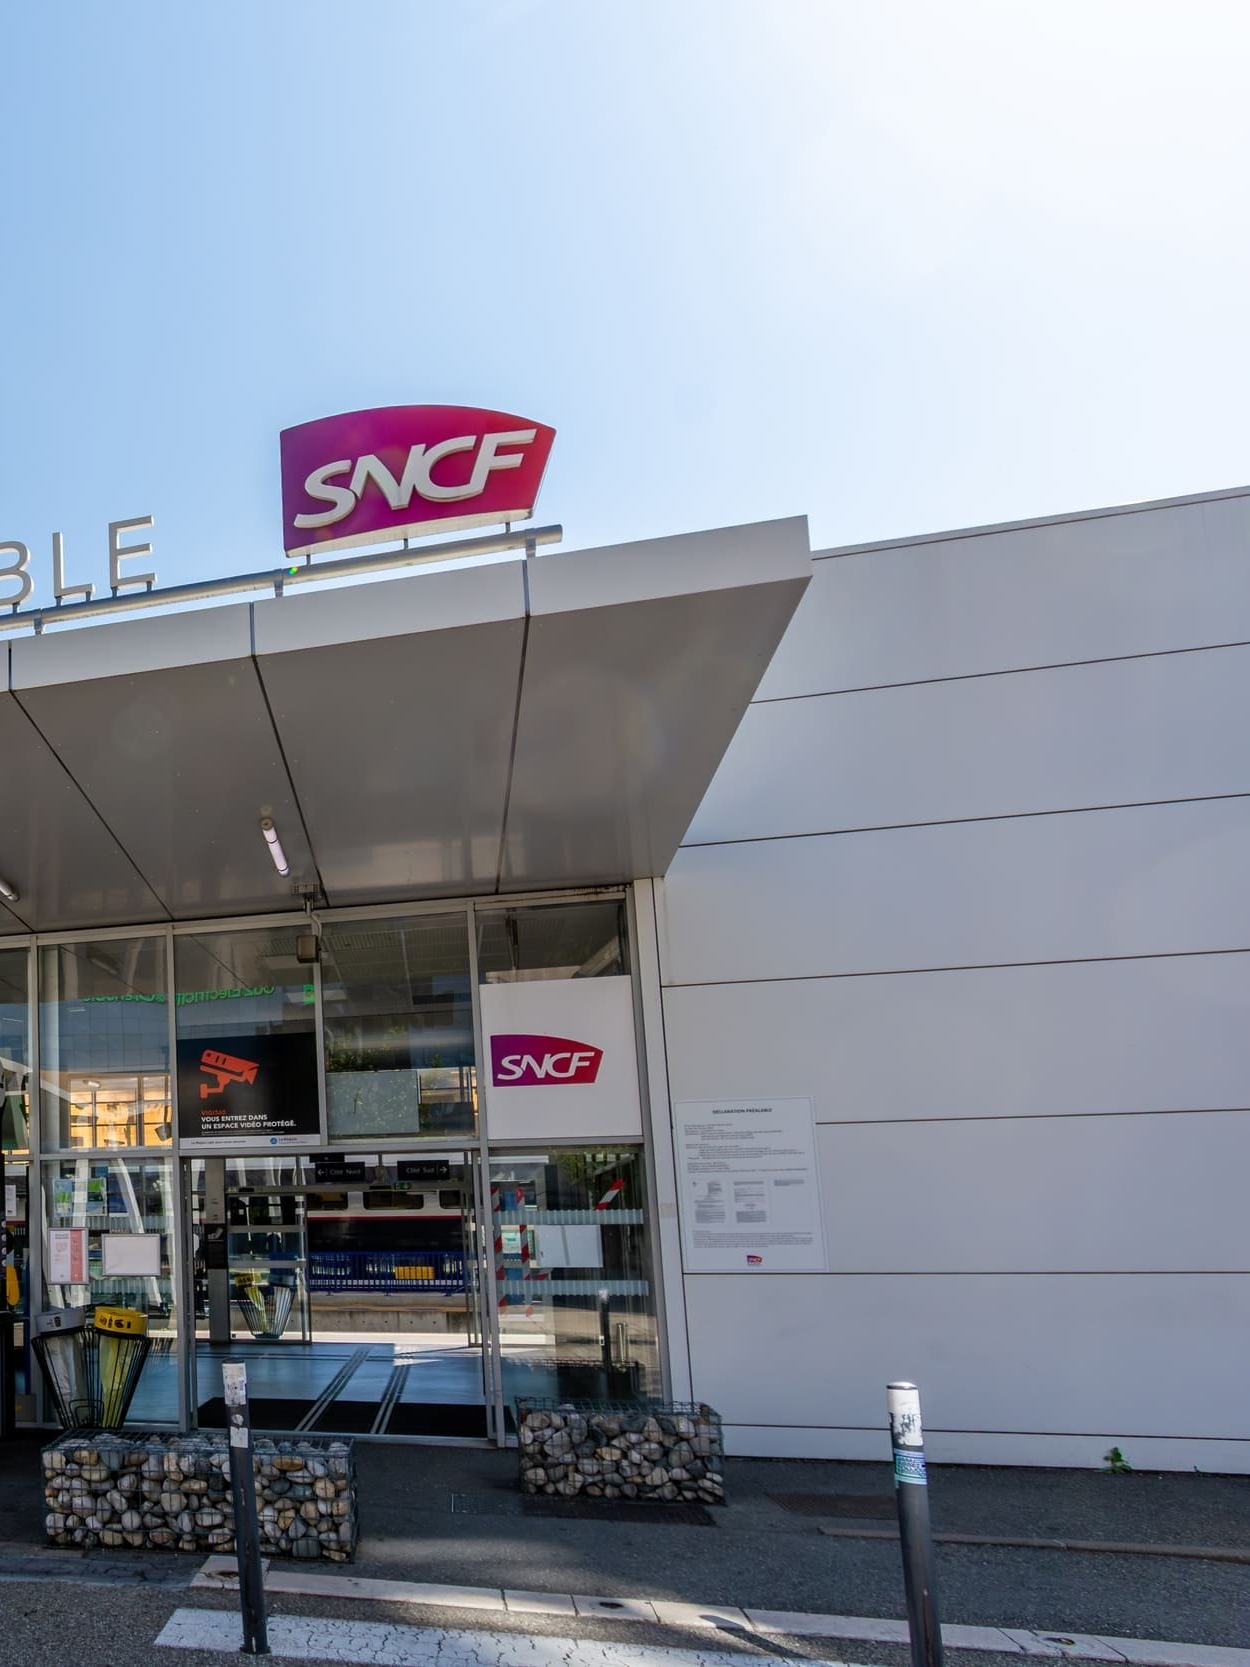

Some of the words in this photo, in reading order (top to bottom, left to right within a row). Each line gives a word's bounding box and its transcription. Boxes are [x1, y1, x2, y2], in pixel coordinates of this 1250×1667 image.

[293, 428, 538, 529] SNCF
[496, 1051, 595, 1081] SNCF
[240, 1120, 262, 1128] VIDÉO
[262, 1119, 297, 1127] PROTÉGÉ.
